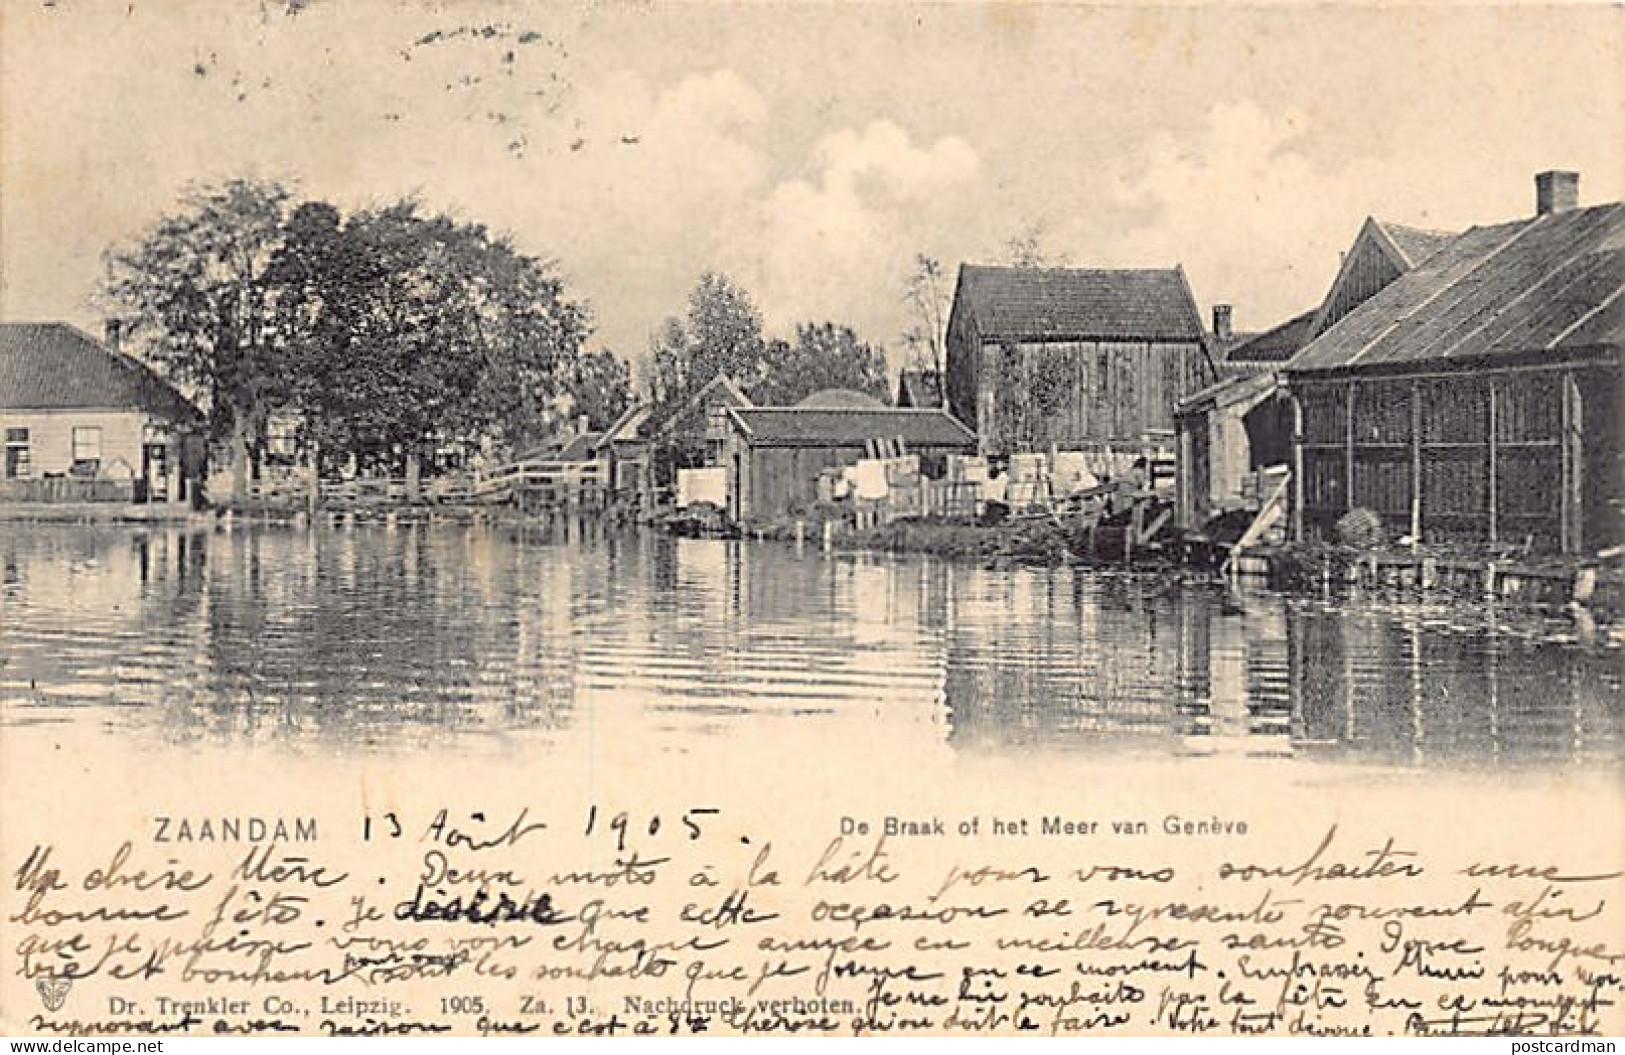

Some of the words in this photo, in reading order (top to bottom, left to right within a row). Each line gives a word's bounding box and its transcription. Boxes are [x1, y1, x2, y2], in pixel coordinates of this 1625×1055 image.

[154, 817, 318, 843] ZAANDAM
[364, 813, 402, 842] 13
[840, 816, 869, 836] De
[884, 816, 945, 836] Braak
[958, 816, 979, 836] of
[993, 816, 1028, 836] het
[1042, 816, 1098, 836] Meer
[1112, 820, 1147, 836] van
[1163, 815, 1248, 836] Genève
[420, 850, 524, 888] Deux
[748, 842, 781, 887] la
[928, 865, 1050, 903] pour
[1075, 866, 1175, 883] vous
[1218, 823, 1424, 886] souhaiter
[1452, 861, 1625, 882] une
[579, 900, 648, 934] que
[1024, 899, 1073, 917] se
[16, 933, 91, 955] que
[913, 936, 971, 951] en
[108, 950, 164, 980] et
[474, 952, 517, 979] les
[686, 960, 748, 998] que
[747, 960, 811, 997] je
[1498, 965, 1563, 996] pour
[1219, 979, 1256, 1005] la
[109, 996, 146, 1015] Dr.
[155, 996, 260, 1015] Trenkler
[321, 996, 411, 1018] Leipzig.
[519, 996, 554, 1014] Za.
[623, 996, 746, 1014] Nachdruck
[476, 1015, 541, 1037] que
